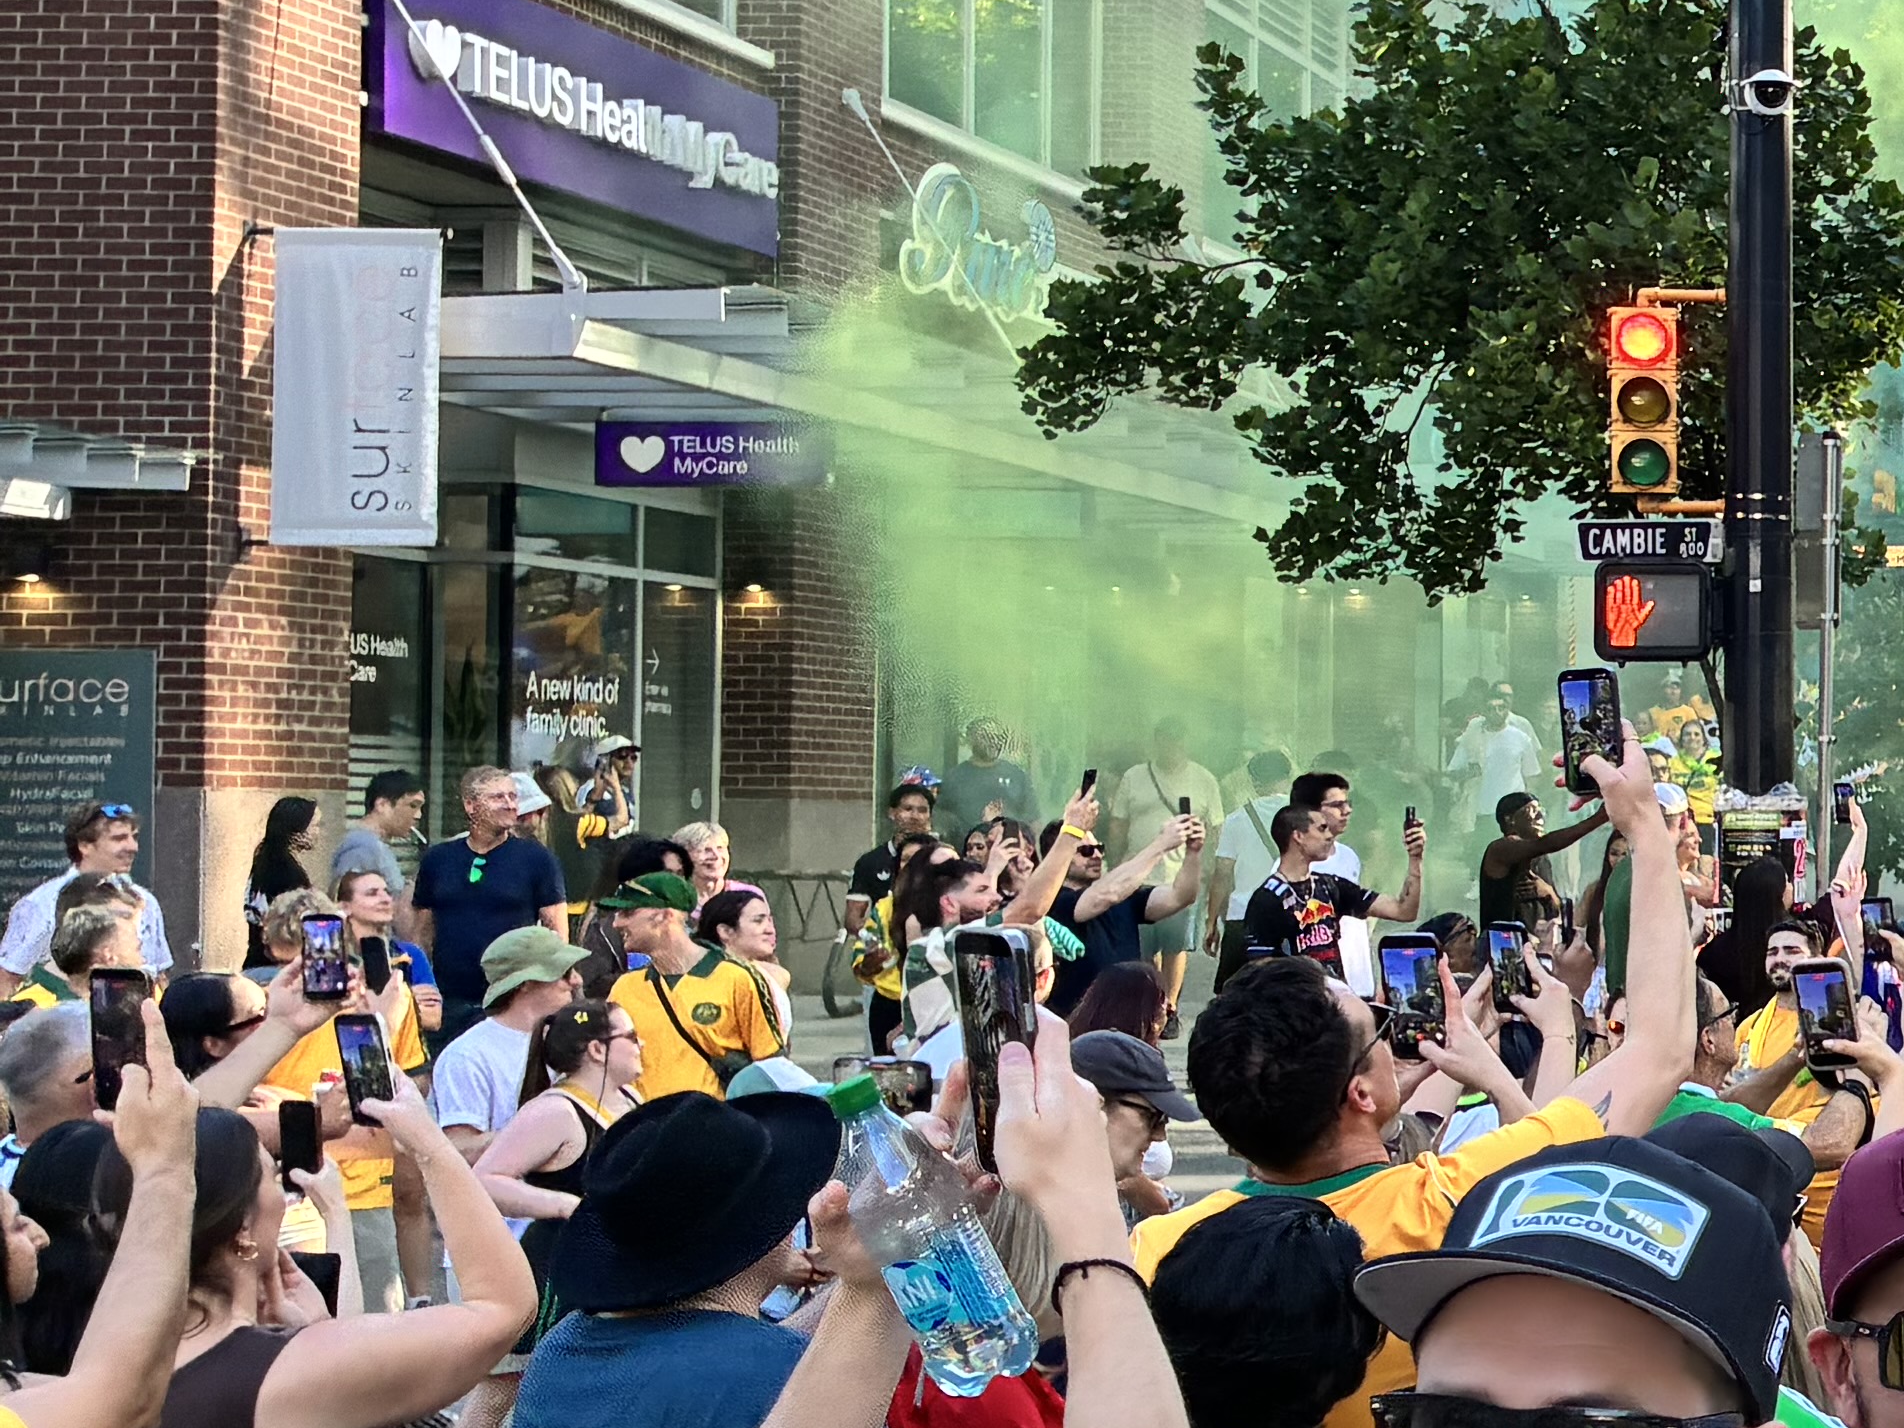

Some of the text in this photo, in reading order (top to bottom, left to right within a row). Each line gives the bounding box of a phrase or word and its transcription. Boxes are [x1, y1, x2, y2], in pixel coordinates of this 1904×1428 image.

[460, 32, 575, 126] TELUS
[669, 435, 800, 454] TELUS Health
[673, 457, 748, 478] MyCare
[1587, 527, 1698, 556] CAMBIE ST
[349, 659, 377, 683] Care
[0, 672, 129, 703] urface
[526, 671, 539, 699] A
[541, 679, 572, 702] new
[574, 675, 603, 705] kind
[605, 676, 620, 705] of
[526, 707, 570, 742] family
[1625, 1208, 1664, 1235] FIFA
[1512, 1214, 1679, 1269] VANCOUVER
